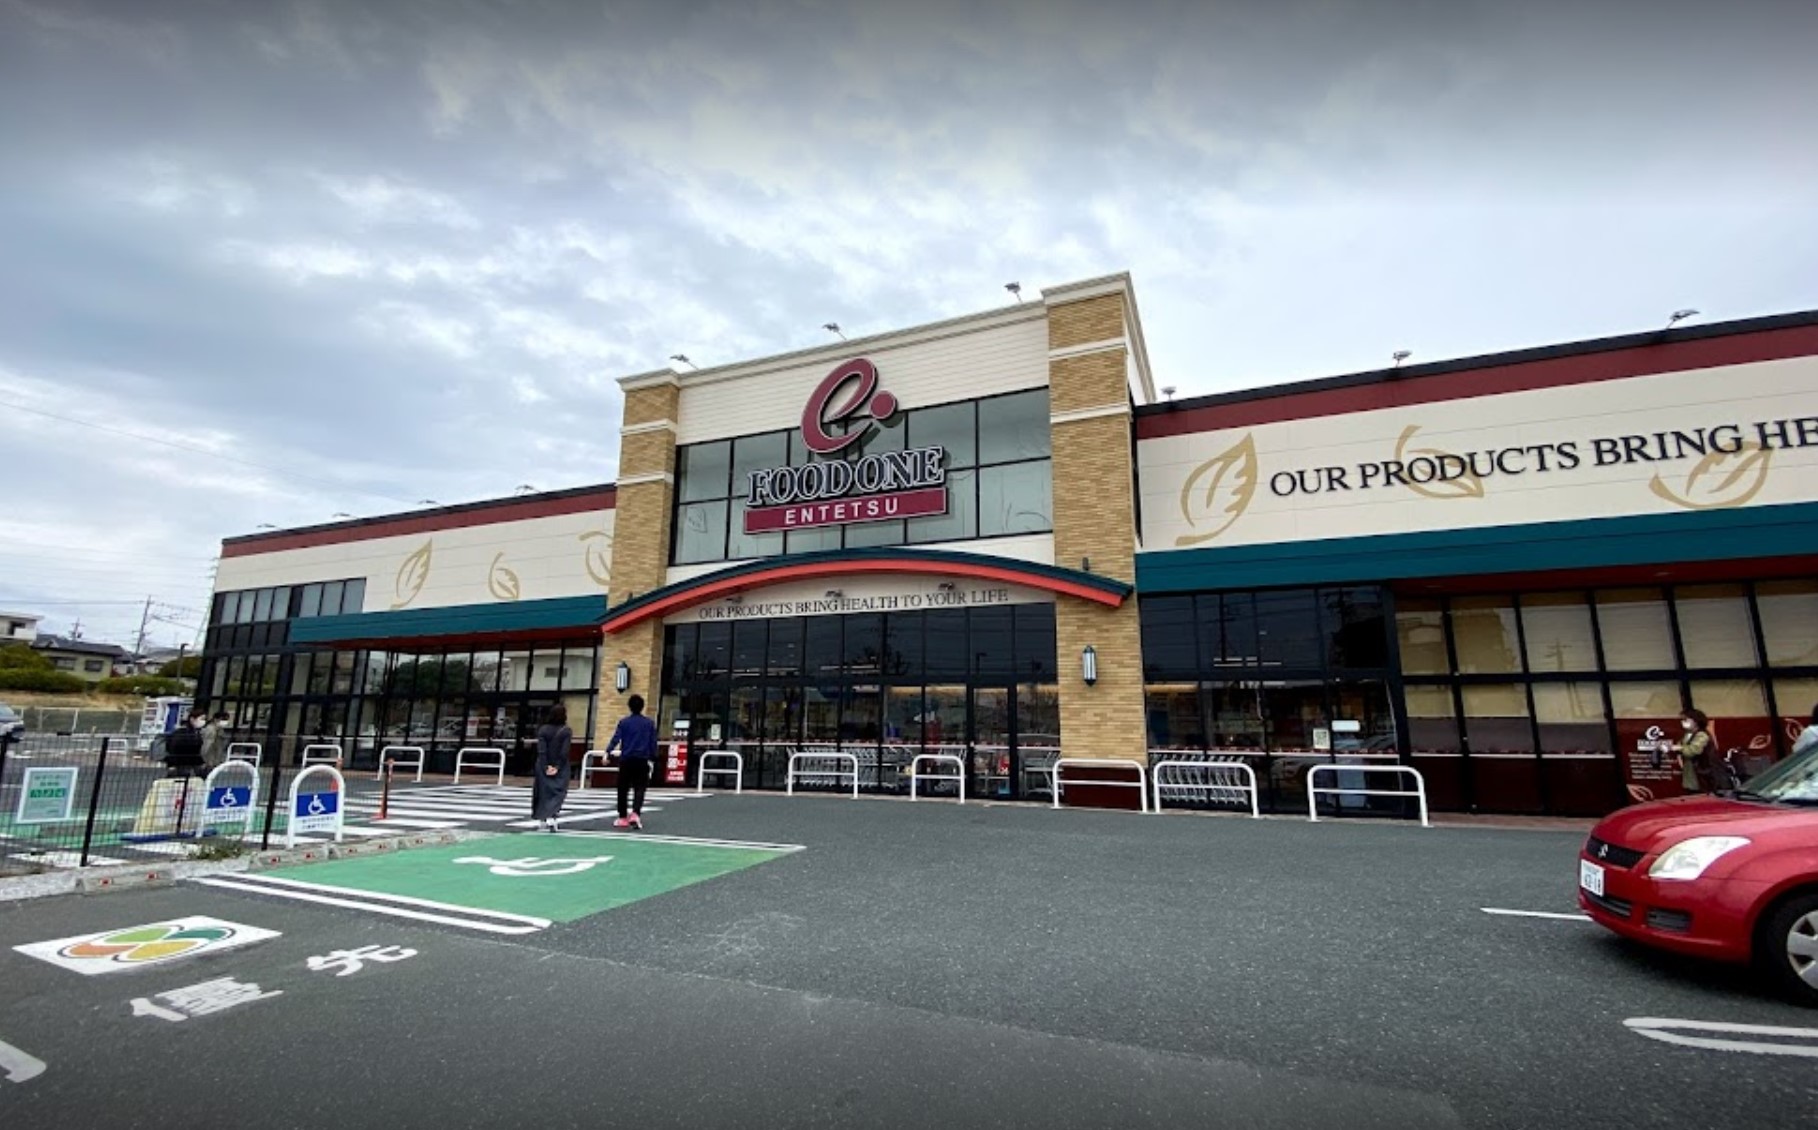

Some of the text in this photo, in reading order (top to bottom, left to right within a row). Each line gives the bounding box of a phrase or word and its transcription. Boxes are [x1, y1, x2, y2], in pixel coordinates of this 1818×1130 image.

[746, 446, 944, 507] FOOD ONE
[1270, 416, 1818, 496] OUR PRODUCTS BRING HE
[784, 497, 898, 525] ENTETSU
[700, 588, 1009, 619] OUR PRODUCTS BRING HEALTH TO YOUR LIFE
